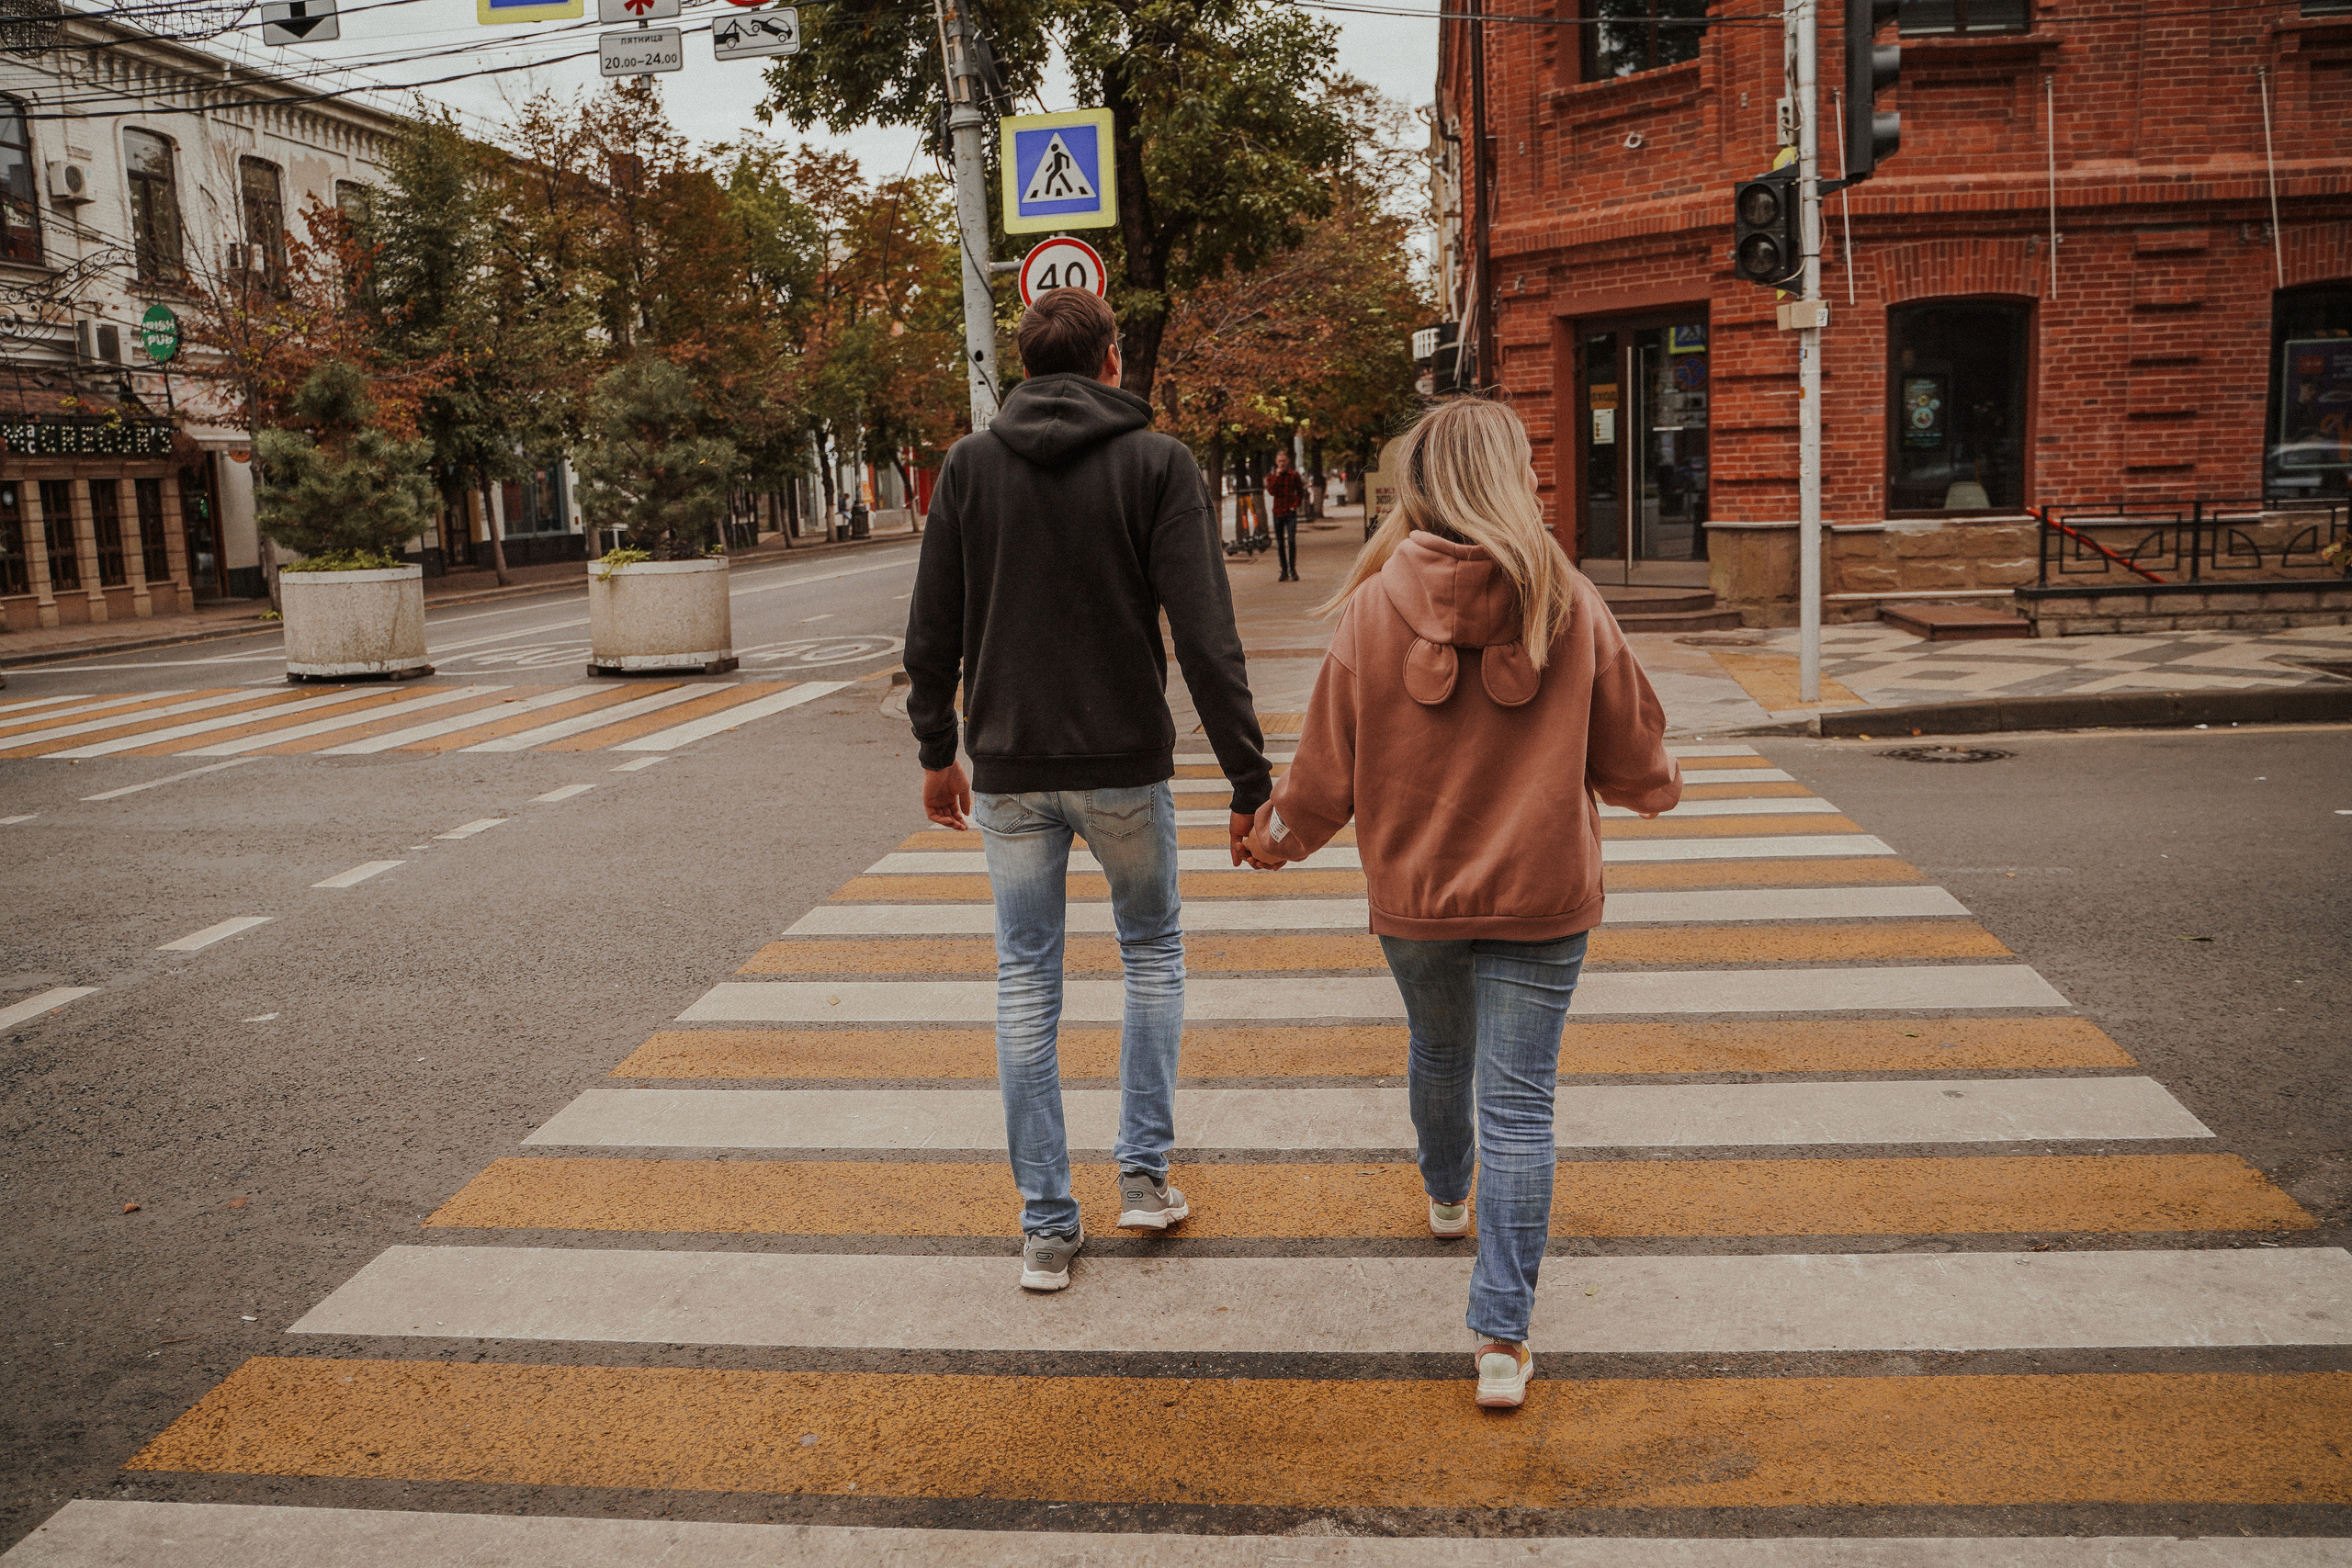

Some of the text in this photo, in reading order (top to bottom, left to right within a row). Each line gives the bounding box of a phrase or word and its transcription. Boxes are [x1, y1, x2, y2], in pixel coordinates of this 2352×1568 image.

[621, 35, 662, 45] пятница
[1036, 261, 1087, 290] 40
[141, 318, 175, 333] IRISH
[147, 333, 175, 347] PUB
